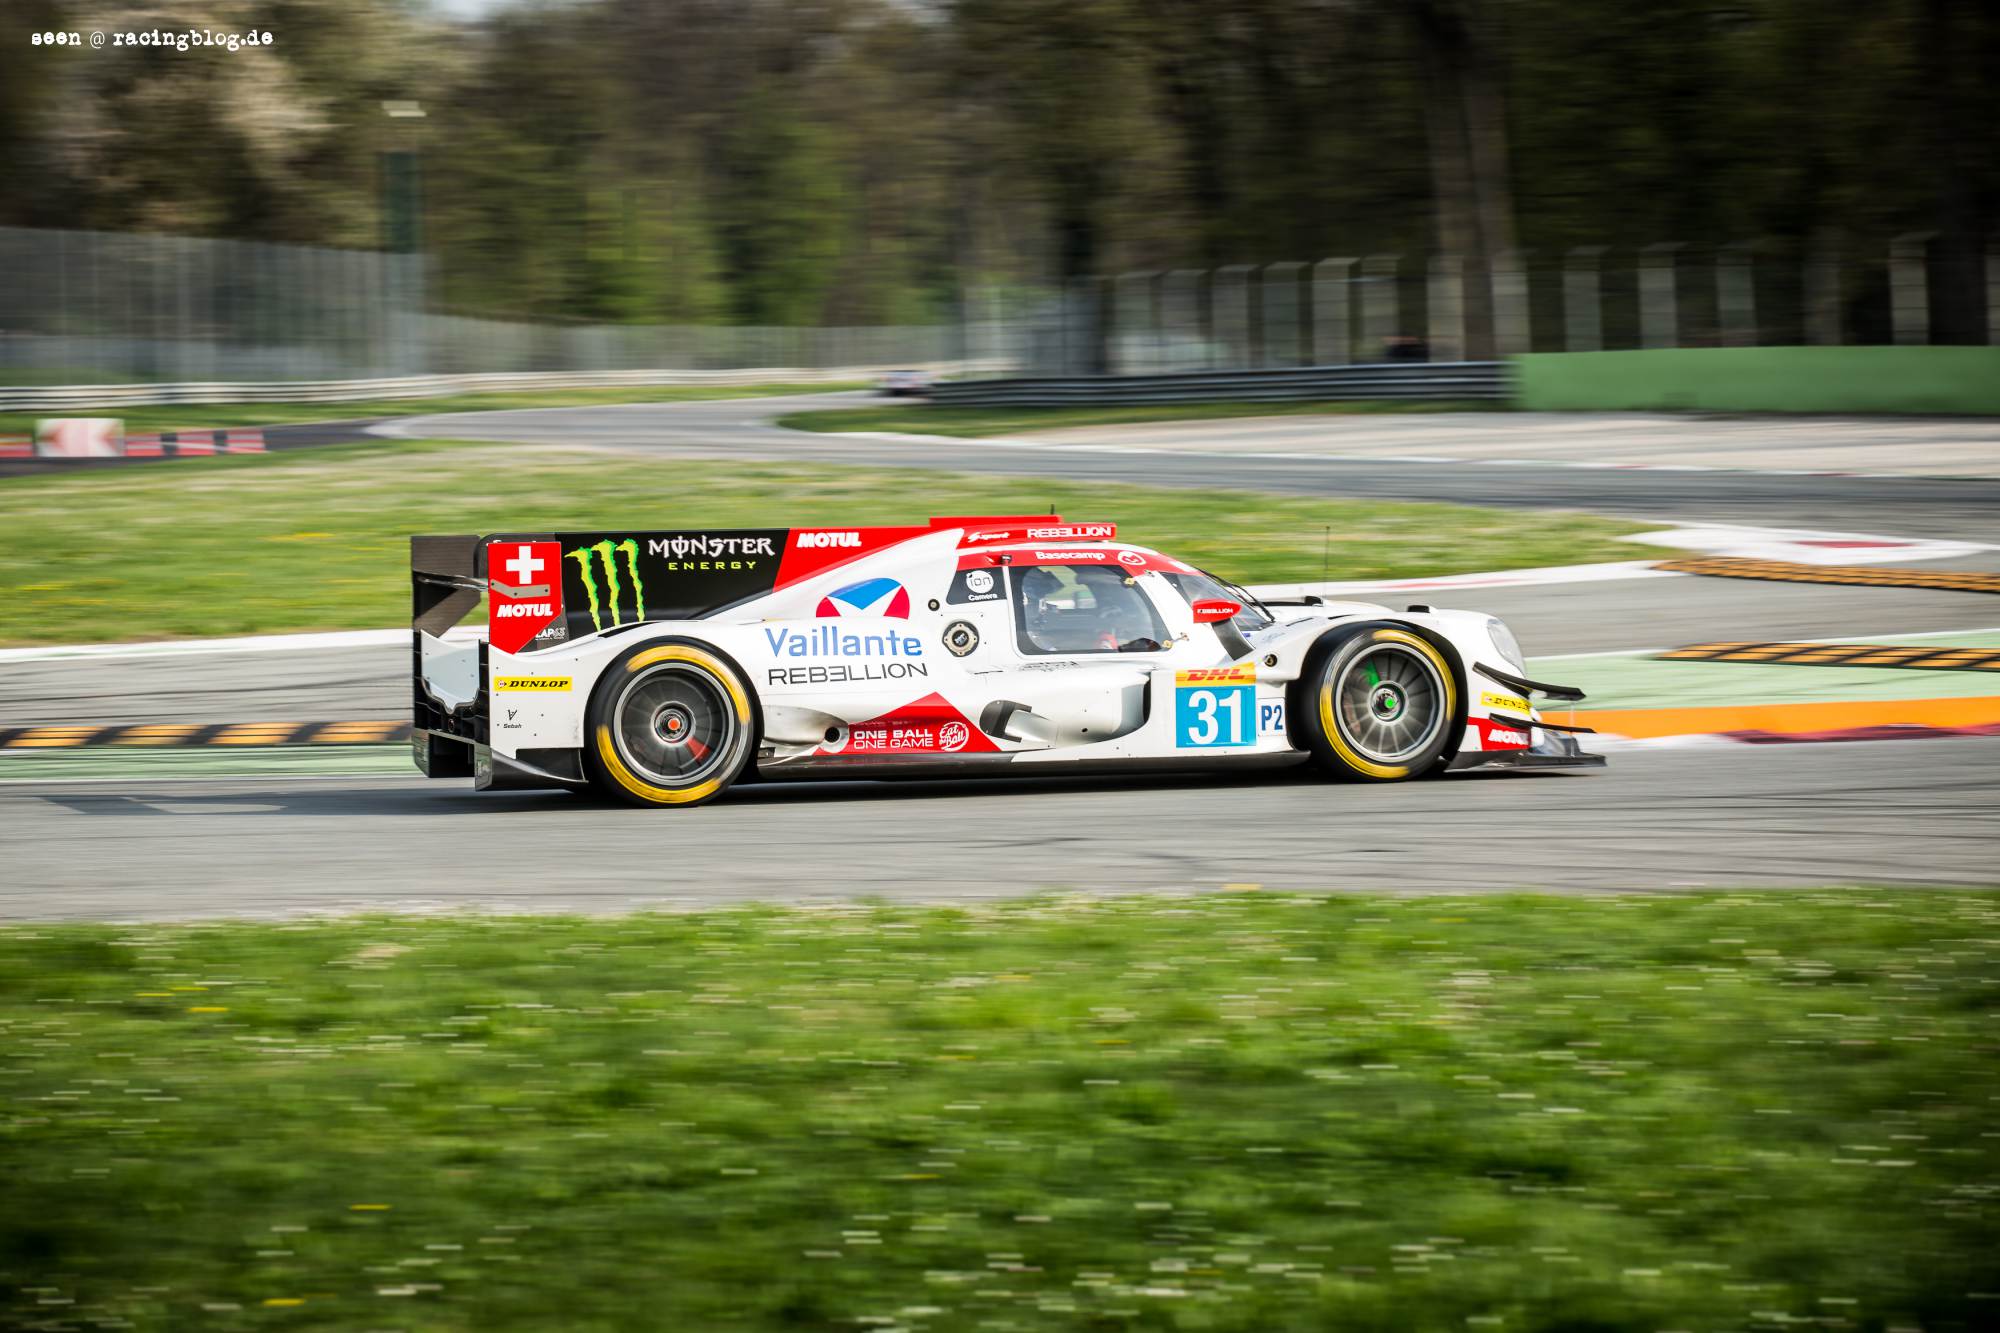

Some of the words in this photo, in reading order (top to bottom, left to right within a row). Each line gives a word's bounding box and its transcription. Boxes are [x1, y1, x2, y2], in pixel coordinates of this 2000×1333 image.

[1026, 526, 1112, 539] REBELLION
[796, 532, 862, 548] MOTUL
[648, 535, 776, 559] MONSTER
[1034, 551, 1106, 561] Basecamp
[668, 561, 757, 571] ENERGY
[968, 593, 998, 602] Camera
[496, 603, 554, 618] MOTUL
[764, 625, 923, 658] Vaillante
[767, 662, 929, 686] REBELLION
[1186, 668, 1245, 681] DHL
[508, 680, 569, 688] DUNLOP
[1188, 689, 1242, 745] 31
[1261, 704, 1284, 731] P2
[853, 730, 888, 740] ONE
[892, 728, 934, 739] BALL
[853, 739, 887, 749] ONE
[889, 738, 934, 749] GAME
